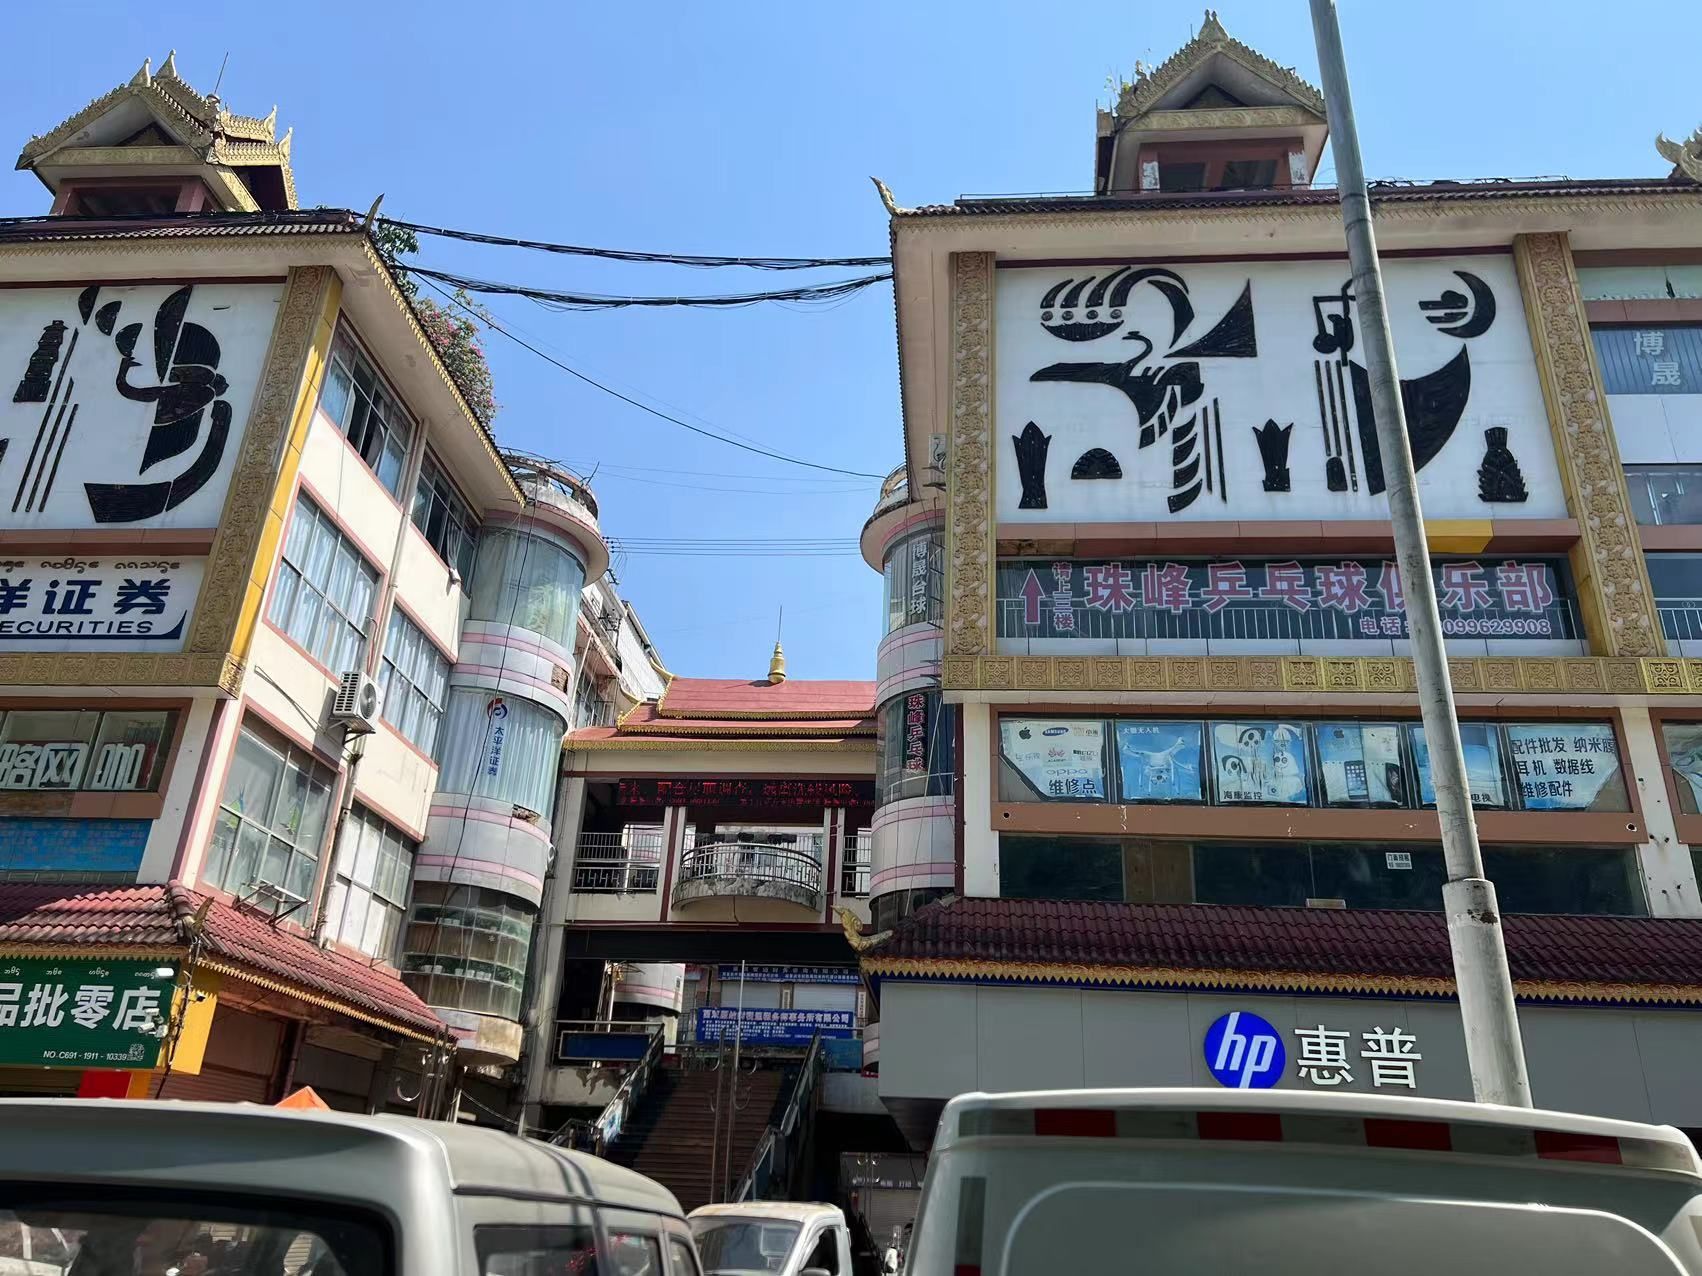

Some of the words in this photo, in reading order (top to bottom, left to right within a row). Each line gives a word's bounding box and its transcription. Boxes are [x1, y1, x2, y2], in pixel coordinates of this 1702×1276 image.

[1052, 561, 1074, 631] 请上三楼
[906, 694, 925, 773] 珠峰乒乓球
[1512, 737, 1567, 755] 配件批发
[487, 726, 504, 776] 太平洋证券
[1518, 760, 1547, 776] 耳机
[1553, 759, 1595, 775] 数据线
[1049, 779, 1096, 795] 维修点
[1520, 781, 1573, 798] 维修配件
[1214, 1011, 1277, 1088] hp
[1294, 1024, 1422, 1089] 惠普
